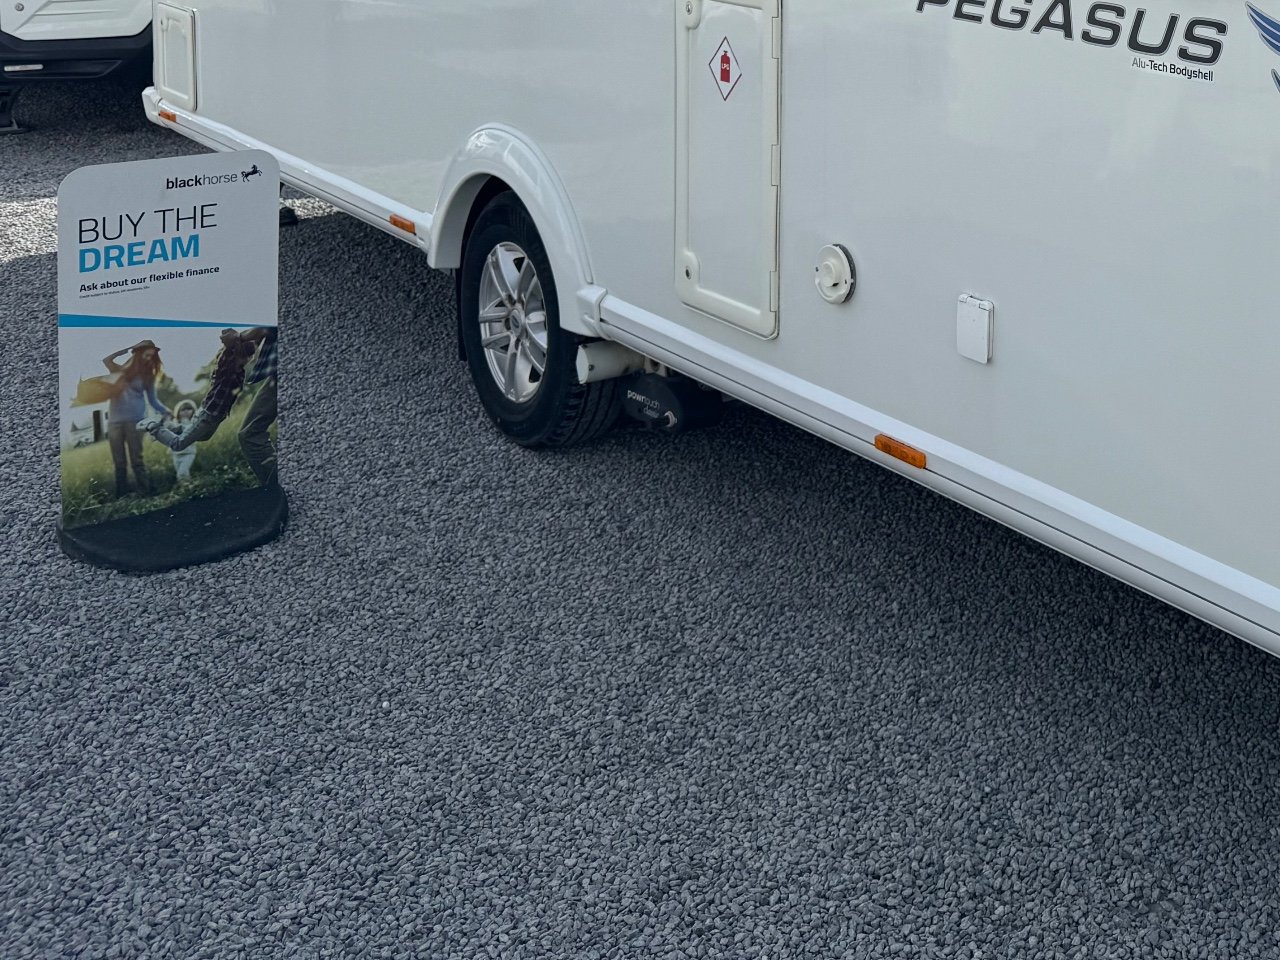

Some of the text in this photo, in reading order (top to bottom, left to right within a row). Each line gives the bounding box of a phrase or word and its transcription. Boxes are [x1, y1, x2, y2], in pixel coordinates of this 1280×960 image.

[1132, 57, 1214, 81] Alu-Tech Bodyshell
[166, 173, 238, 189] blackhorse
[78, 203, 218, 244] BUY THE
[79, 234, 200, 273] DREAM
[79, 266, 220, 292] Ask about our flexible finance
